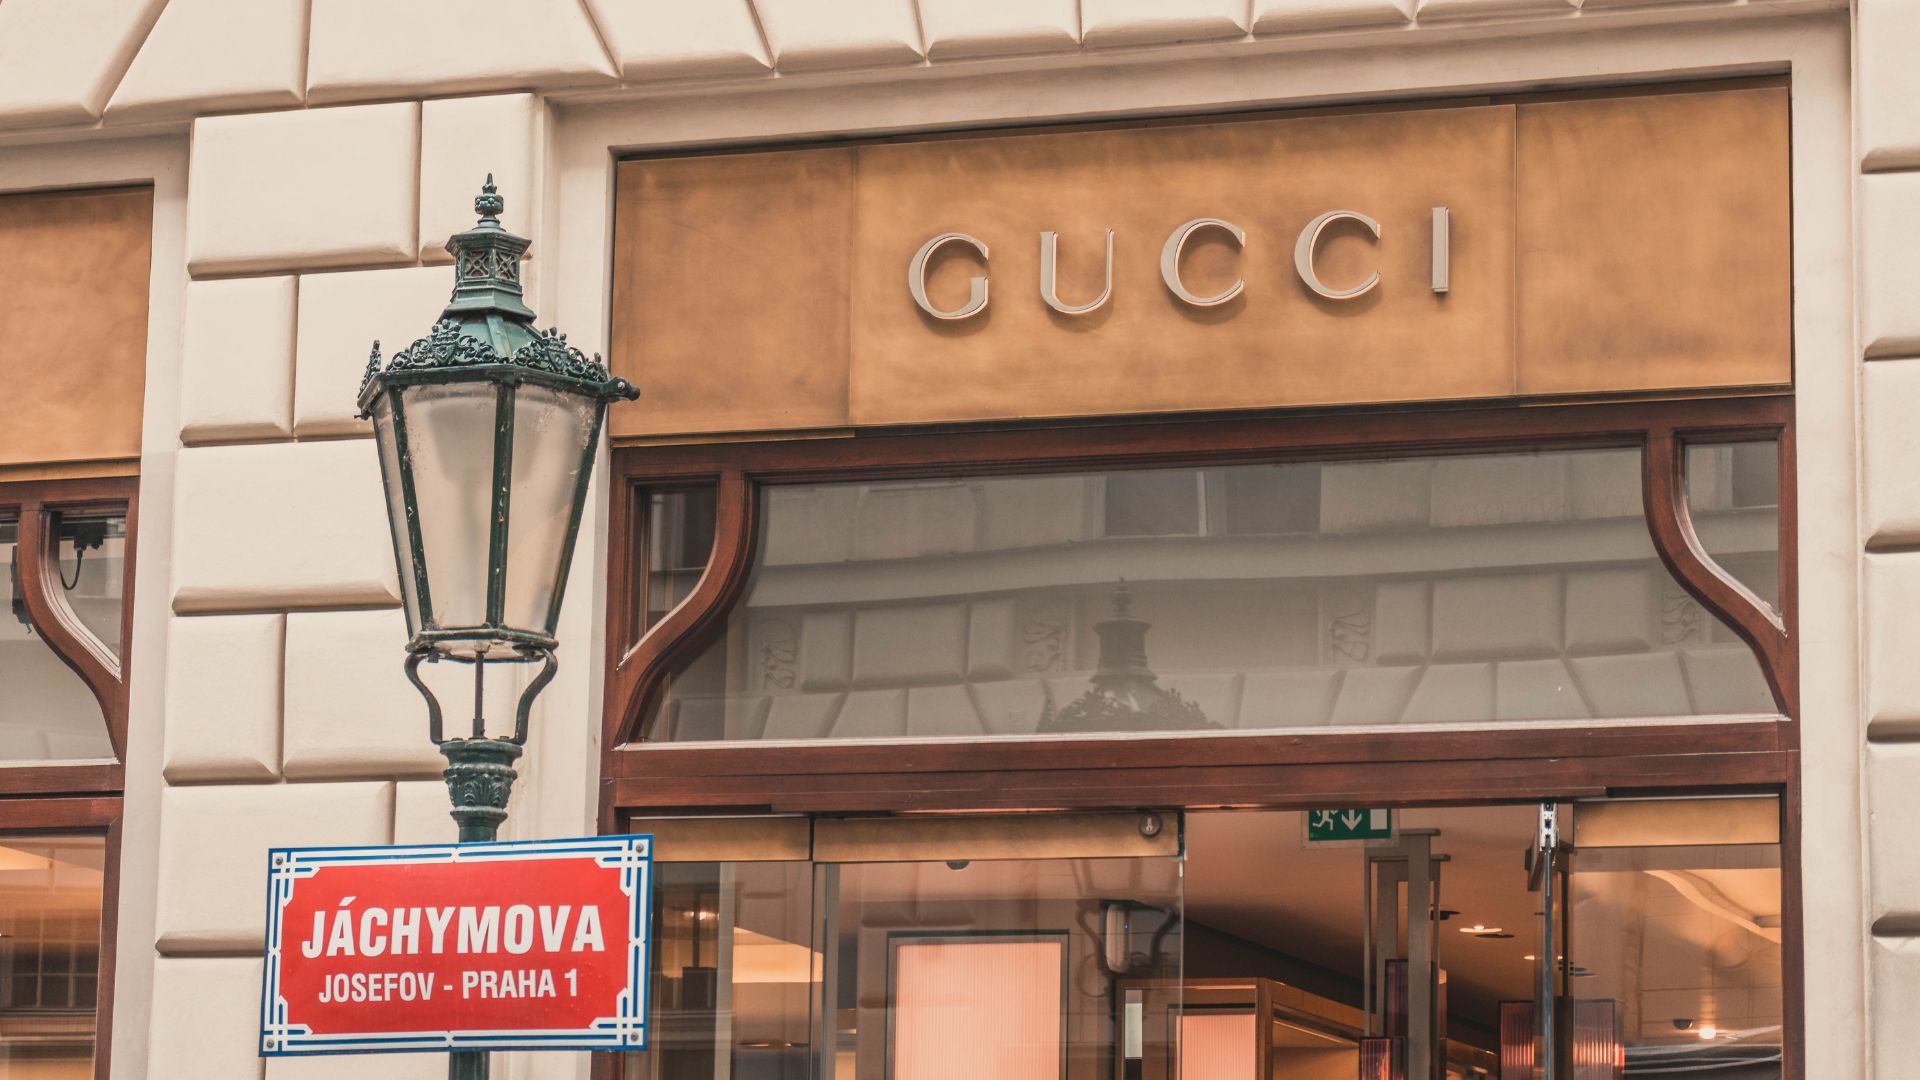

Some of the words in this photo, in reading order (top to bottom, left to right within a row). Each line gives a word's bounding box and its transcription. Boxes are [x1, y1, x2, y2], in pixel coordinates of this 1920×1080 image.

[908, 207, 1449, 320] GUCCI
[301, 896, 606, 959] JÁCHYMOVA
[318, 972, 435, 1003] JOSEFOV
[462, 969, 557, 999] PRAHA
[564, 968, 578, 997] 1
